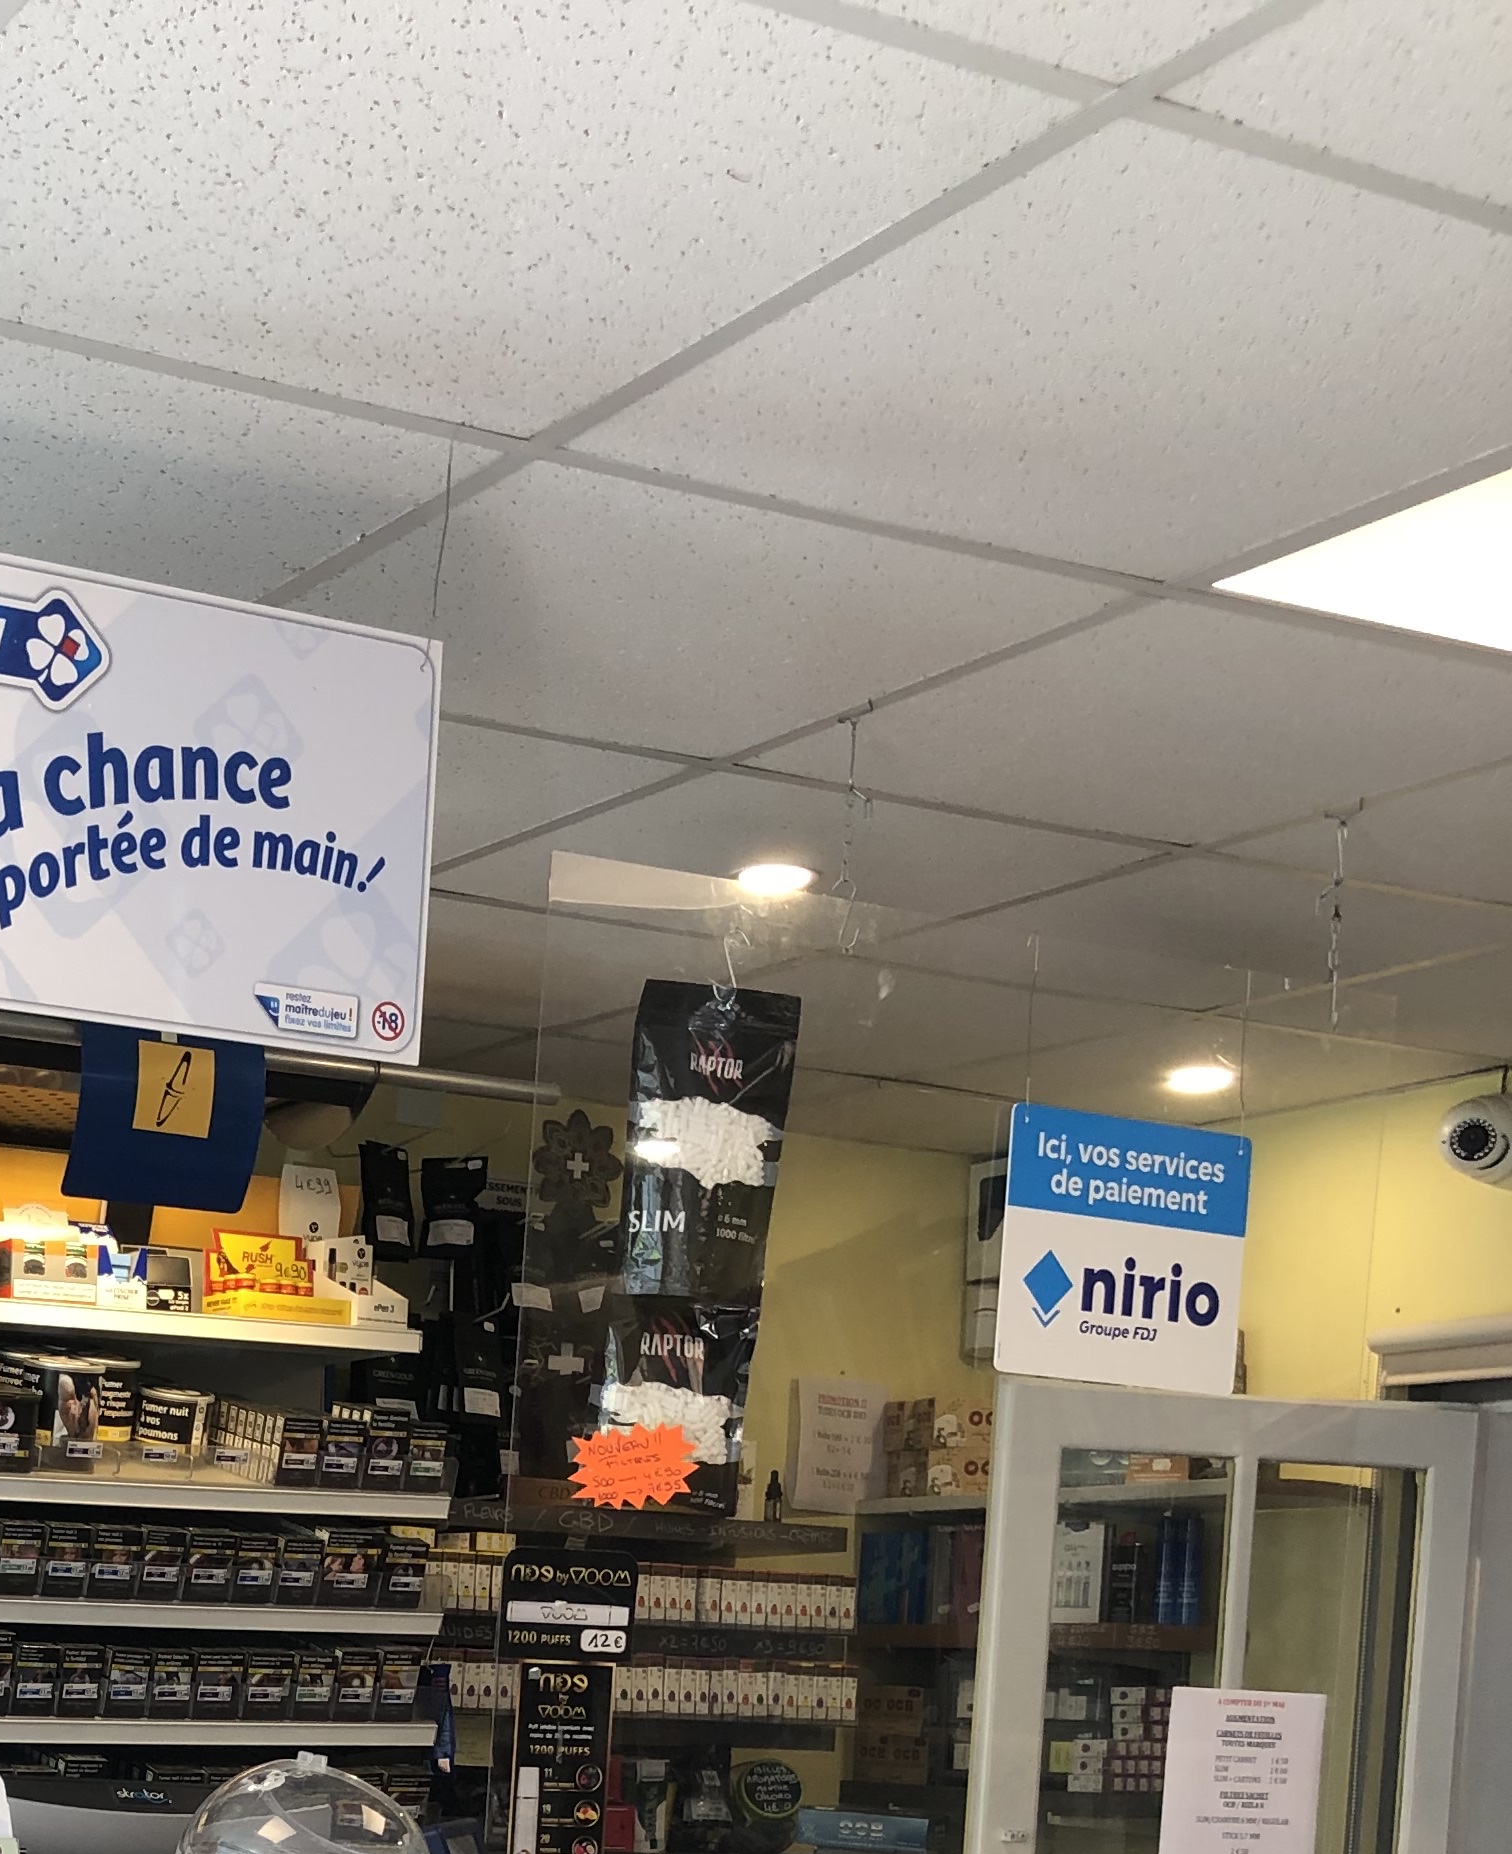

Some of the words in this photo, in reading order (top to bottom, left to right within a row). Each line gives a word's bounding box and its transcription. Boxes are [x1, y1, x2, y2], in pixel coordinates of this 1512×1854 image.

[43, 731, 292, 816] chance
[181, 814, 242, 870] de
[285, 992, 311, 1004] restez
[324, 1019, 351, 1033] limites
[689, 1052, 744, 1081] RAPTOR
[1037, 1131, 1073, 1162] Ici,
[1079, 1142, 1120, 1169] vos
[1126, 1148, 1225, 1184] services
[1050, 1169, 1083, 1196] de
[1088, 1178, 1208, 1216] paiement
[628, 1209, 686, 1234] SLIM
[242, 1251, 274, 1264] RUSH
[1080, 1256, 1220, 1327] nirio
[1079, 1320, 1130, 1341] Groupe
[1132, 1326, 1158, 1342] FDJ
[507, 1629, 537, 1645] 1200
[541, 1634, 571, 1646] PUFFS
